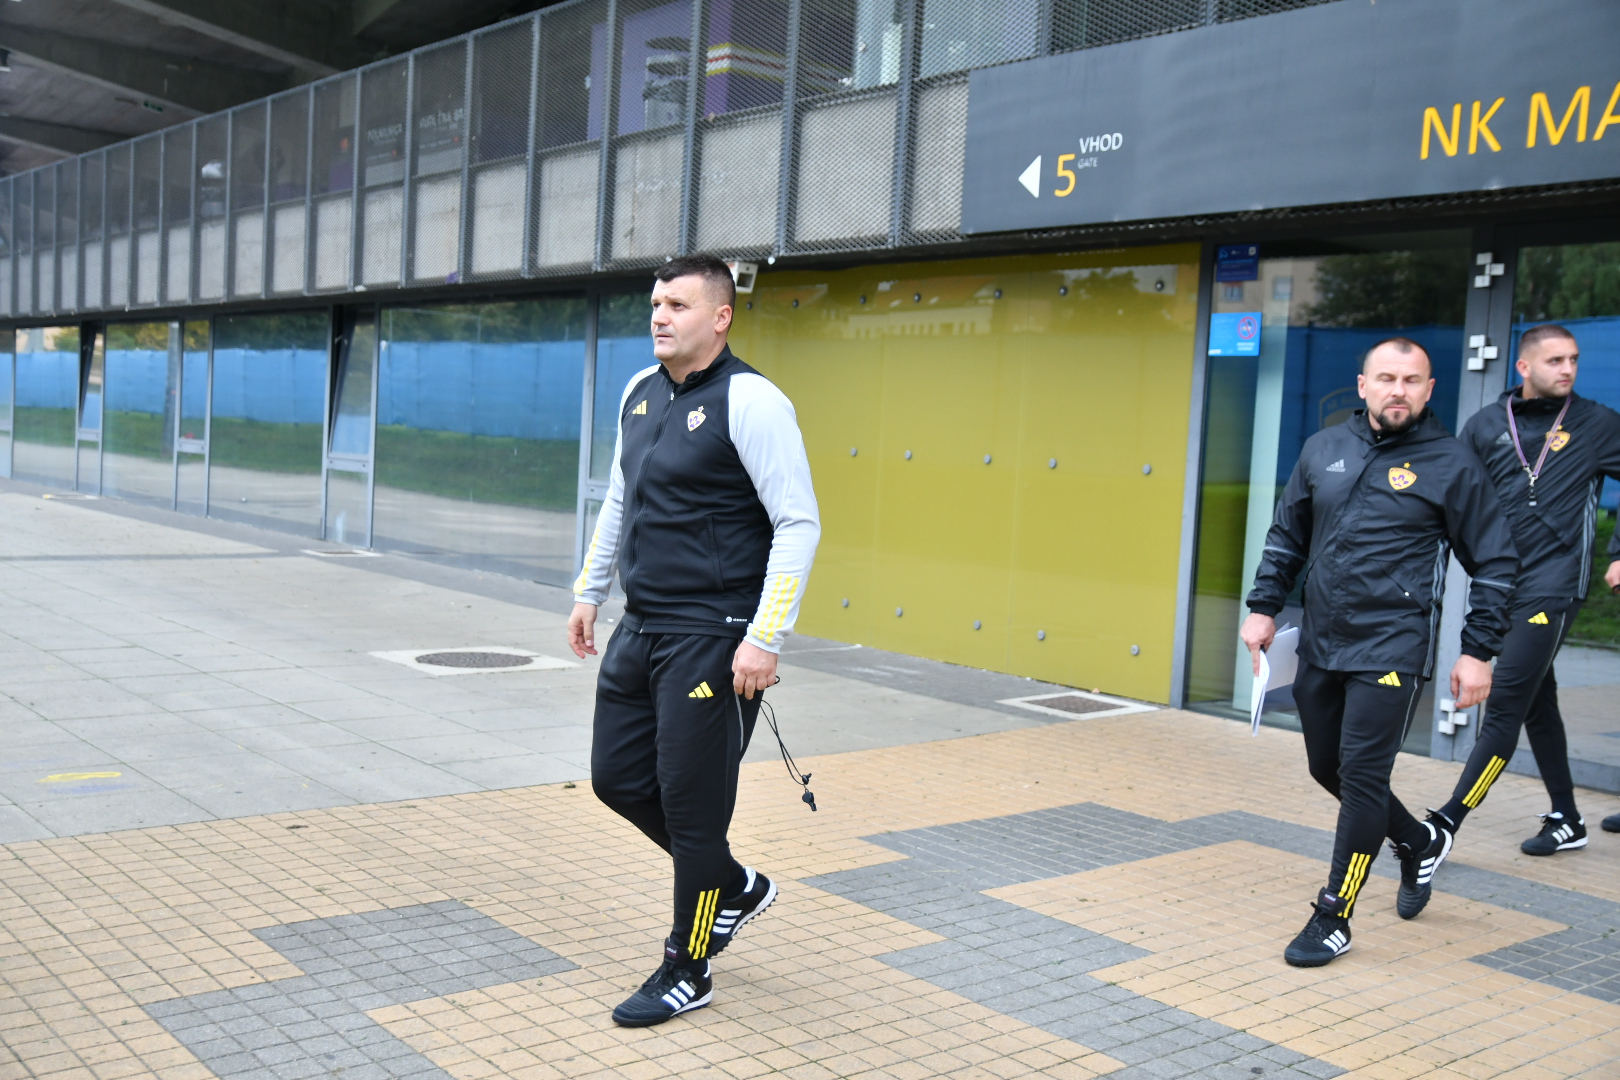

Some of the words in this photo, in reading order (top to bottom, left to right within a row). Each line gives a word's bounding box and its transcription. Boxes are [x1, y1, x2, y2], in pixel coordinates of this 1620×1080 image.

[1079, 132, 1123, 154] VHOD
[1420, 97, 1505, 160] NK
[1054, 153, 1076, 197] 5
[1077, 156, 1099, 169] GATE
